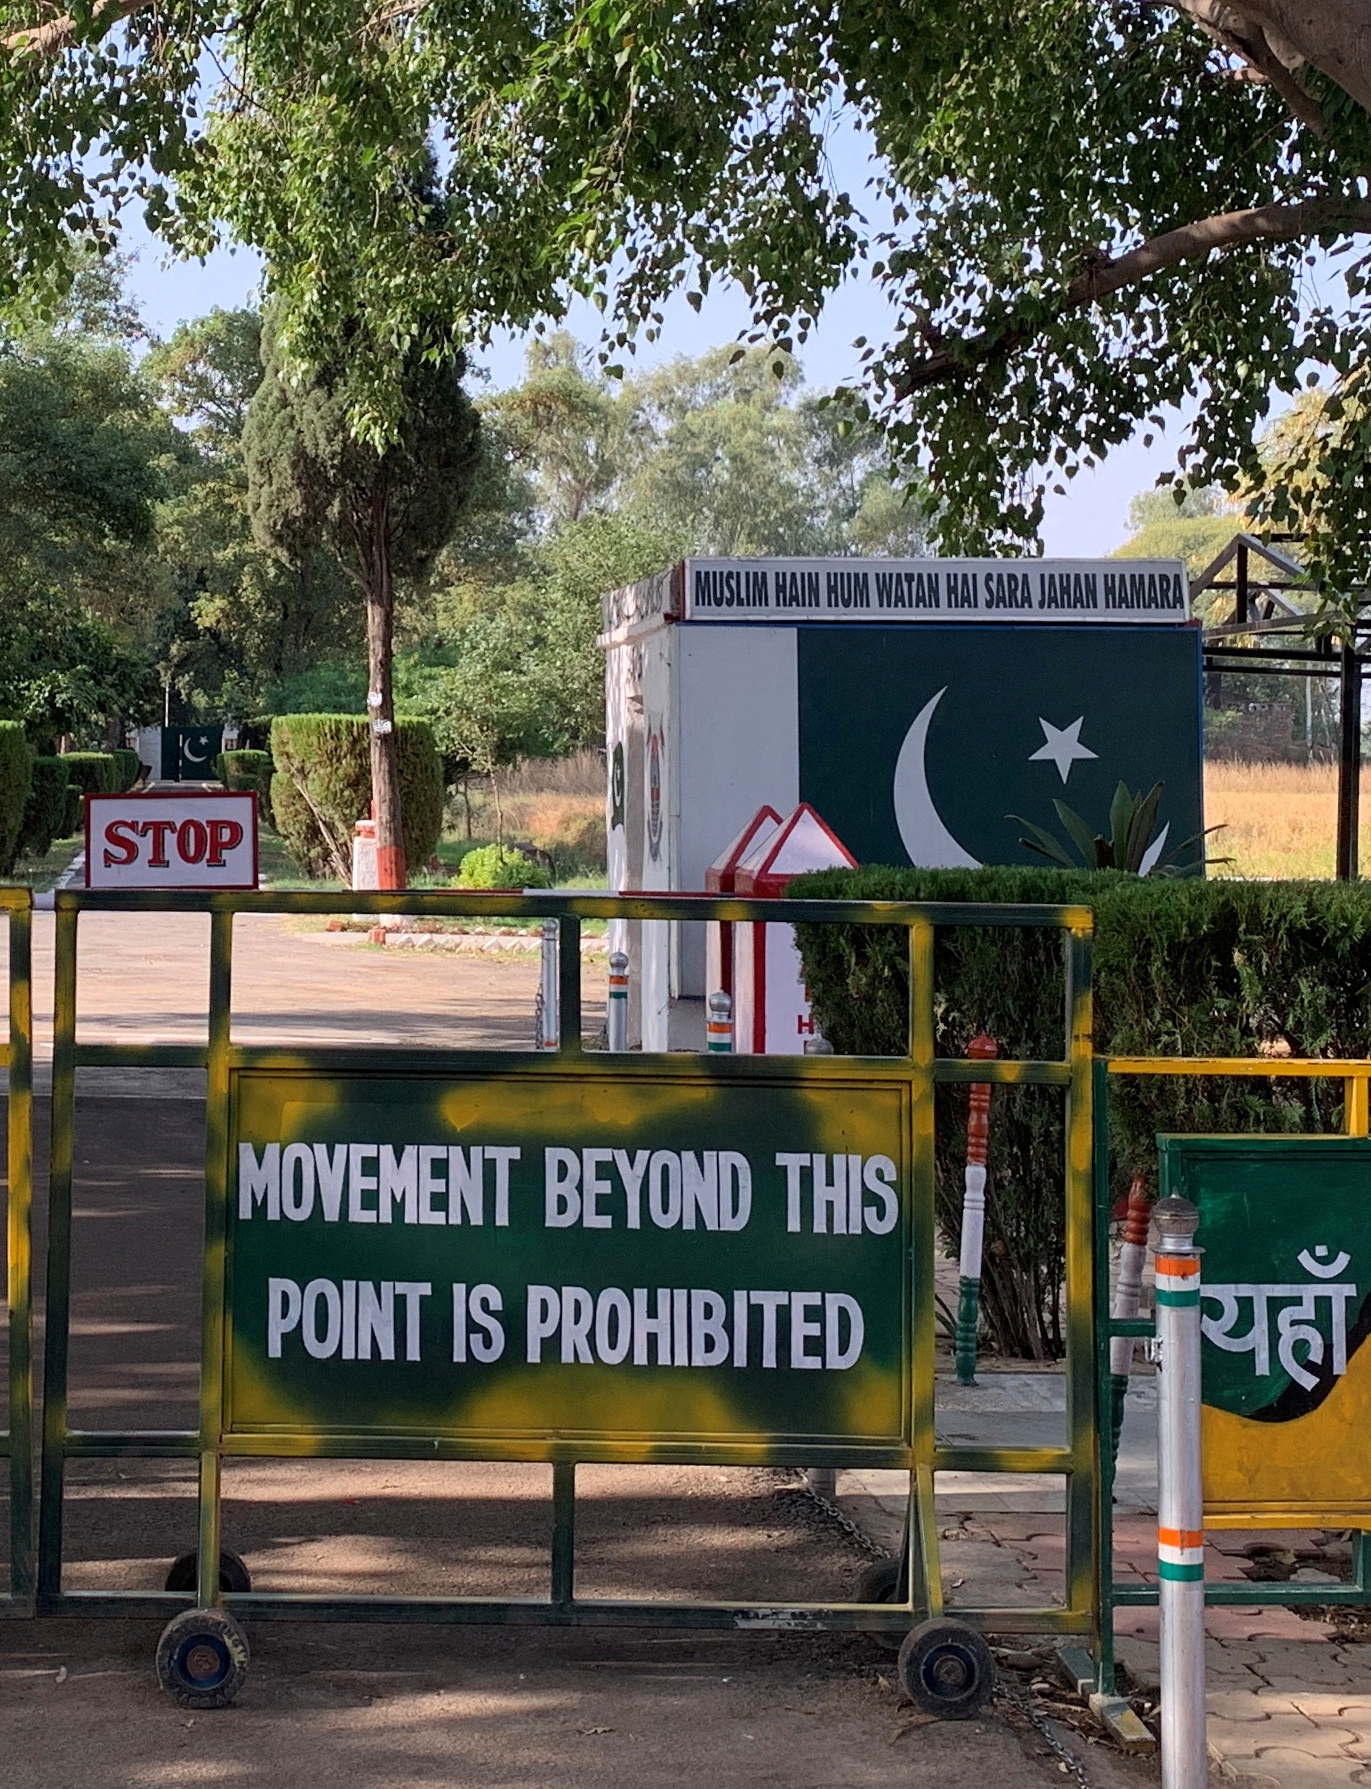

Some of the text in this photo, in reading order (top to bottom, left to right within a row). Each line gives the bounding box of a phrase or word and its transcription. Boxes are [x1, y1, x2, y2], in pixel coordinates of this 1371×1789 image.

[695, 570, 769, 607] MUSLIM
[775, 571, 820, 608] HAIN
[827, 572, 870, 608] HUM
[875, 572, 940, 609] WATAN
[946, 573, 977, 609] HAI
[984, 572, 1033, 609] SARA
[1038, 573, 1098, 610] JAHAN
[1104, 573, 1184, 609] HAMARA
[103, 818, 243, 868] STOP
[238, 1142, 899, 1235] MOVEMENT BEYOND THIS
[268, 1277, 865, 1370] POINT IS PROHIBITED
[1201, 1245, 1357, 1392] यहाँ
